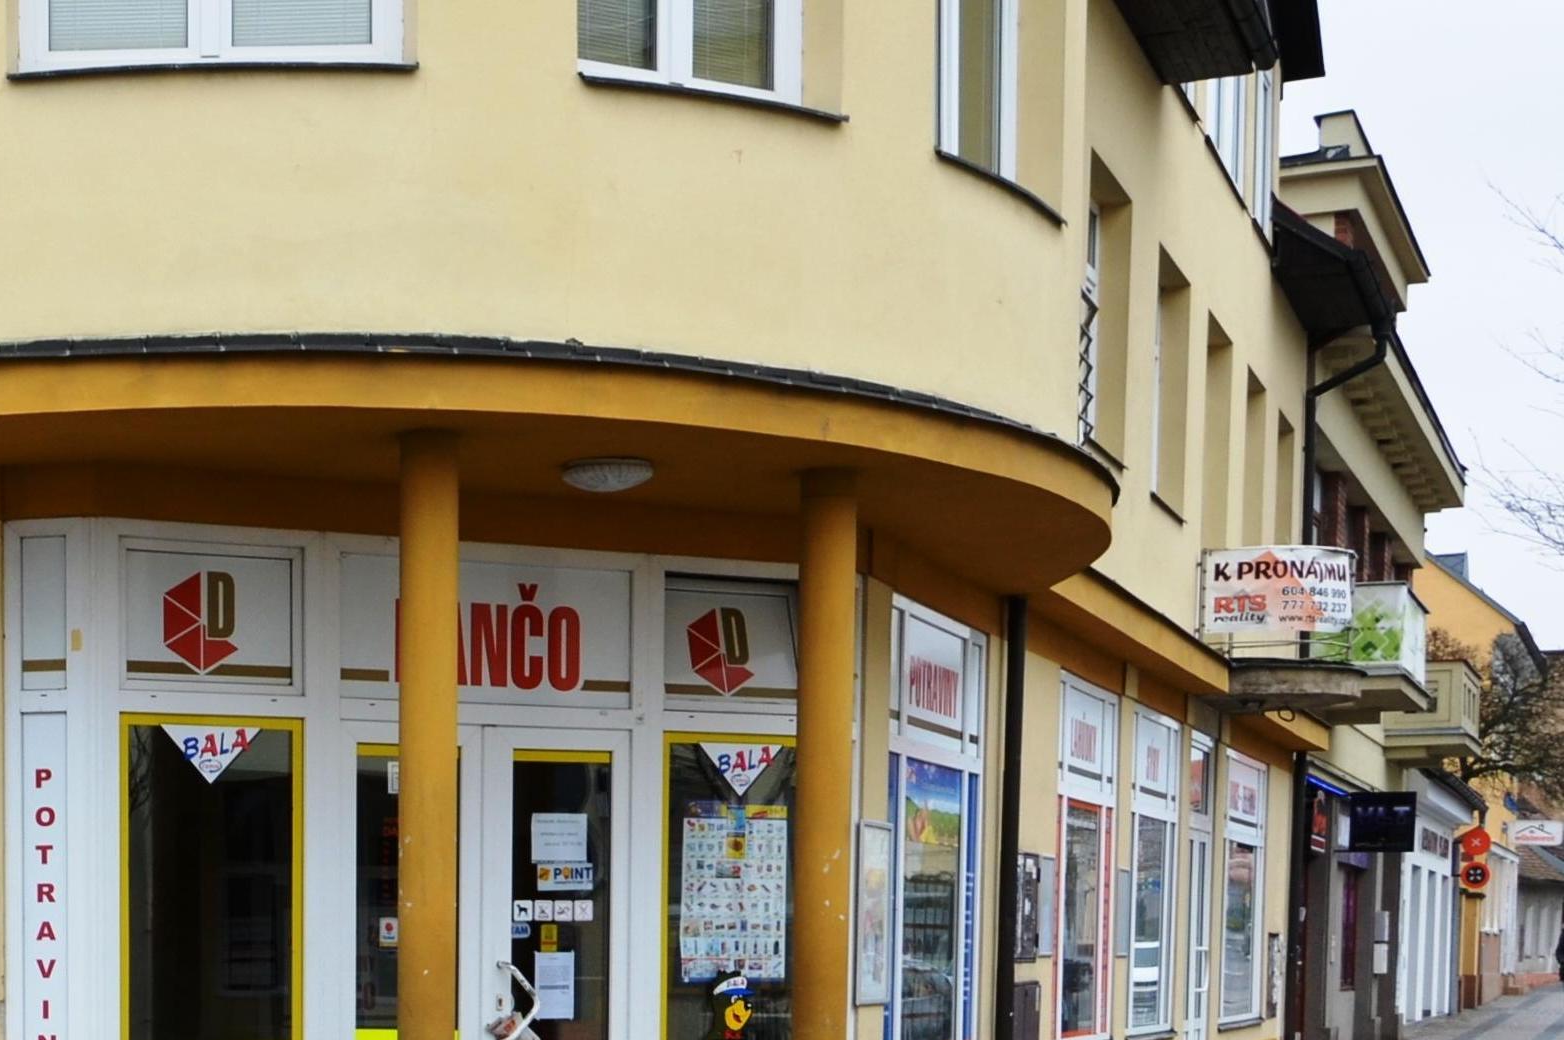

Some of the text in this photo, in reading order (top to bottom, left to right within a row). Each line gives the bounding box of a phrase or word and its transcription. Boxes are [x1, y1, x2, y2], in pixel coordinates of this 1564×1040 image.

[1214, 557, 1347, 583] K PRONÁJMU
[1282, 586, 1305, 596] 604
[1309, 586, 1329, 598] 846
[1214, 594, 1267, 614] RTS
[1282, 600, 1304, 610] 777
[1214, 611, 1266, 625] reality
[395, 583, 581, 692] NČO
[909, 656, 959, 719] POTRAVINY
[183, 729, 251, 761] BALA
[717, 746, 773, 774] BALA
[553, 867, 592, 880] POINT
